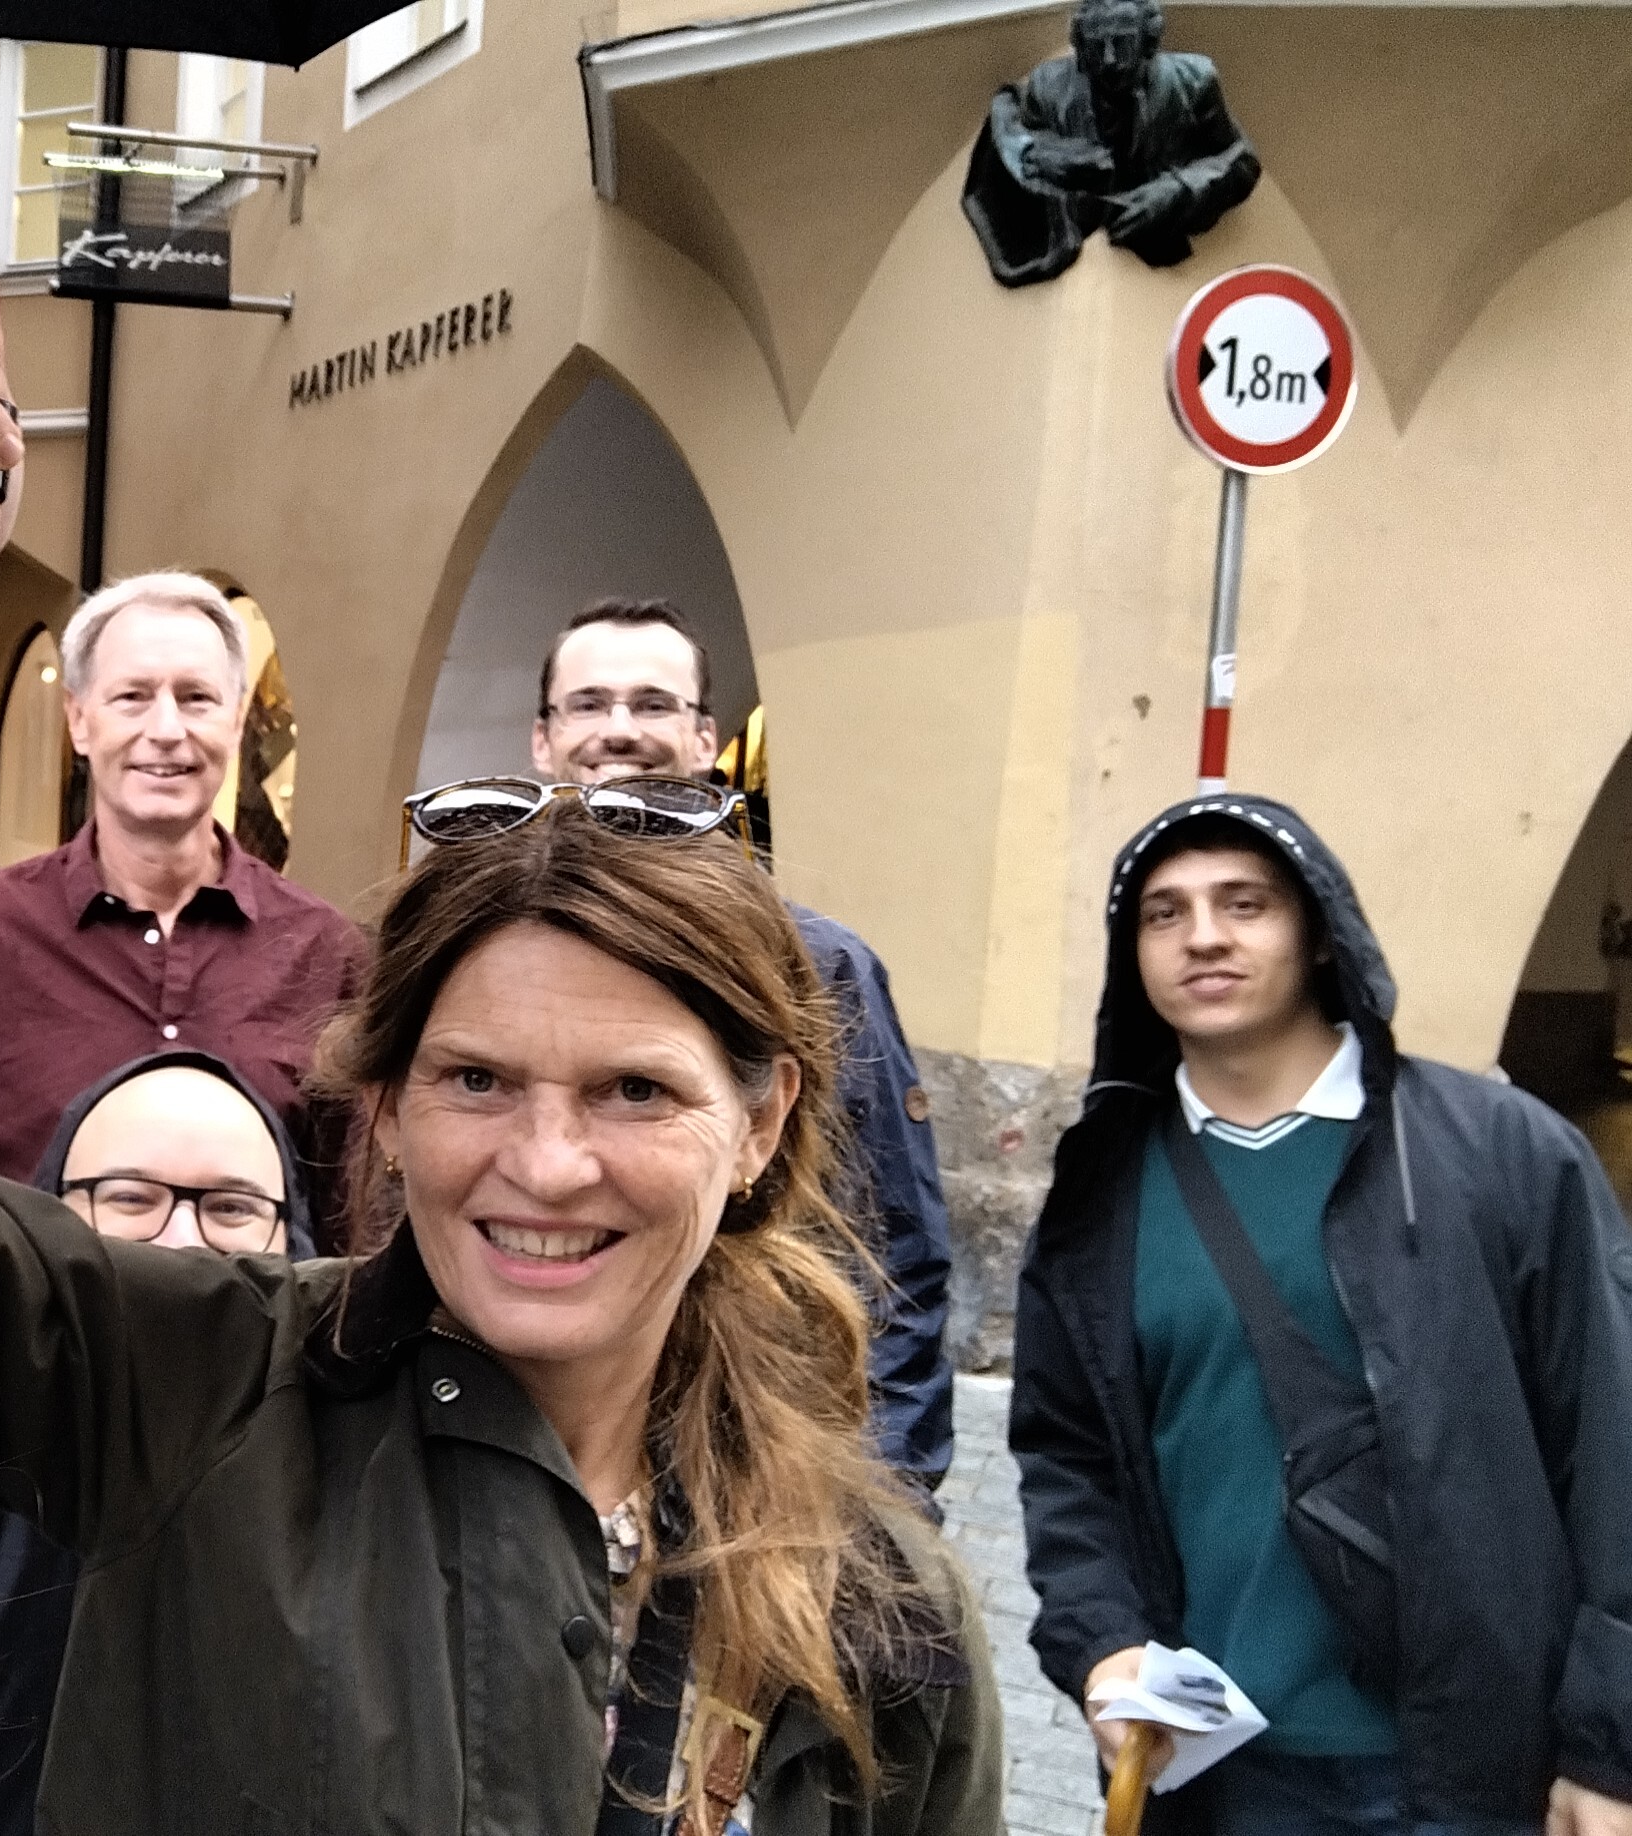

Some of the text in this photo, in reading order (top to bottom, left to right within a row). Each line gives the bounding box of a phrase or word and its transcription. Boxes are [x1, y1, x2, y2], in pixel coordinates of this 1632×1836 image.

[62, 229, 227, 271] Kapferer
[289, 287, 514, 410] MARTIN KAPFERER
